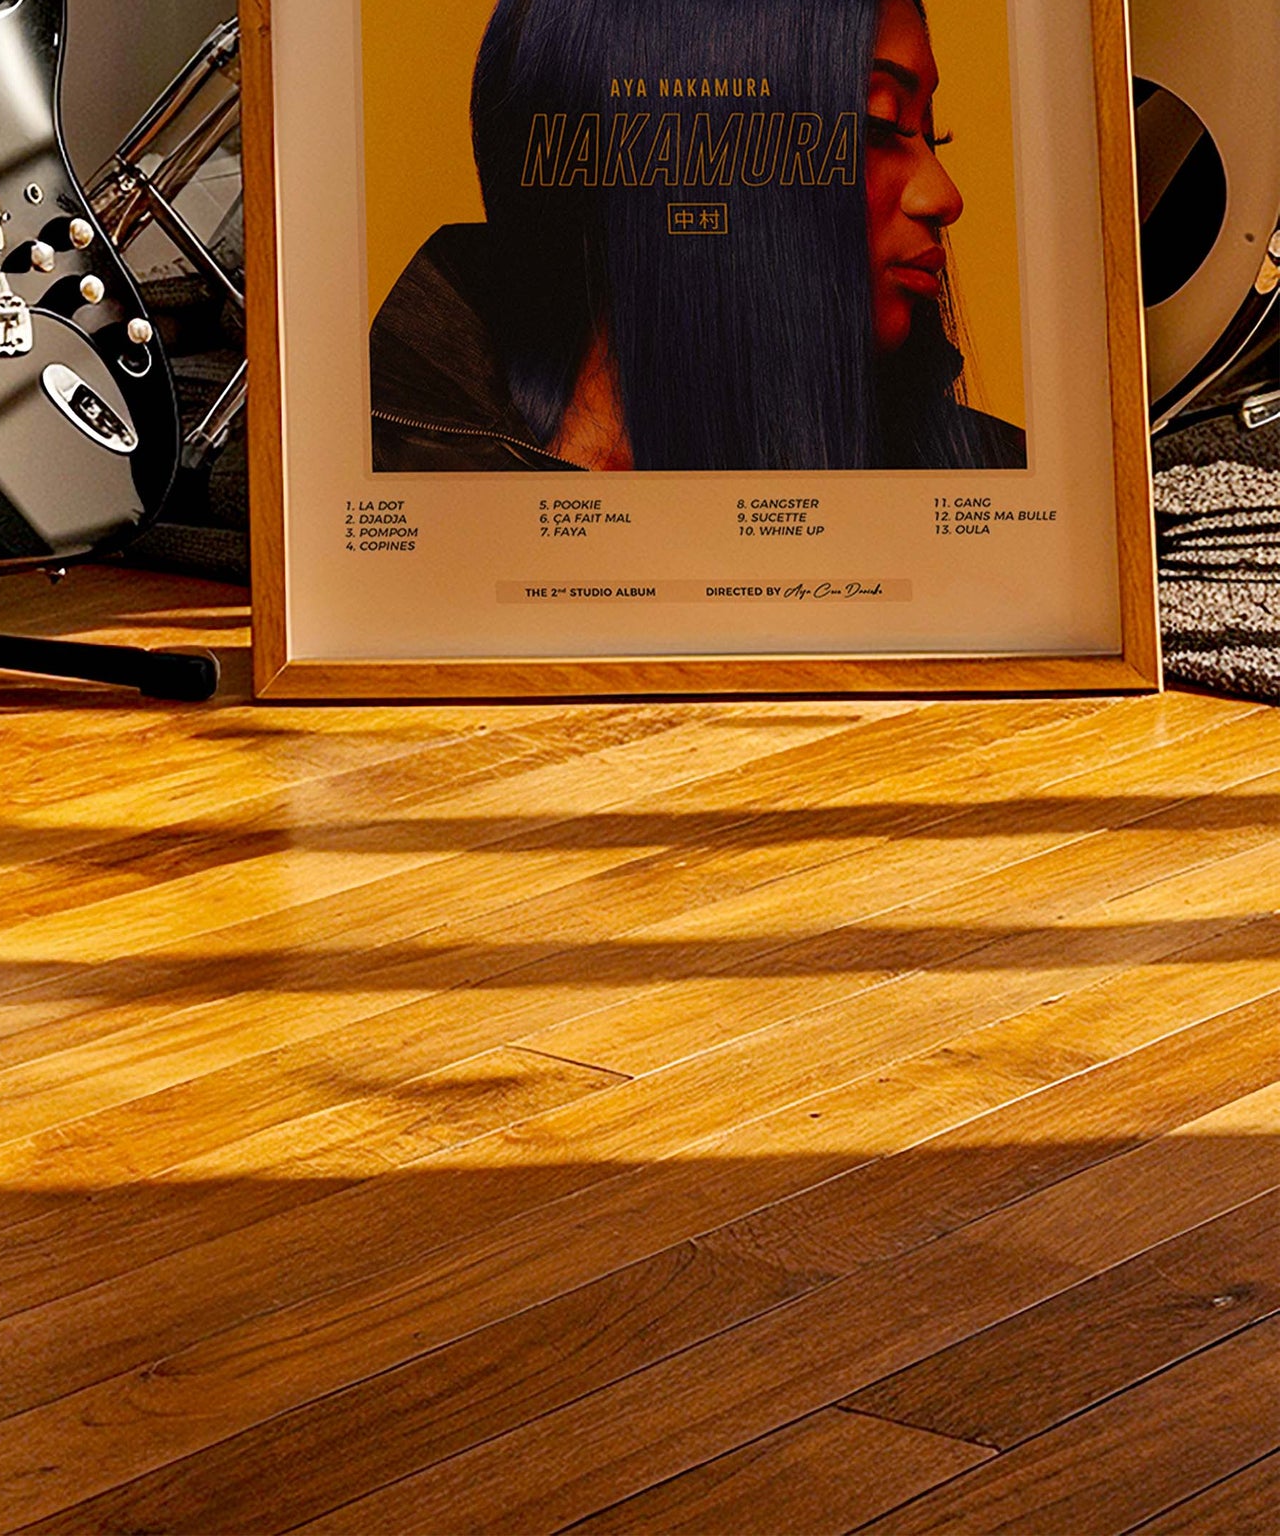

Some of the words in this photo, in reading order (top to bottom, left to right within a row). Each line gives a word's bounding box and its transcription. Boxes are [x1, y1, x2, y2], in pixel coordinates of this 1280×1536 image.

[610, 79, 647, 97] AYA
[659, 78, 770, 97] NAKAMURA
[520, 112, 858, 186] NAKAMURA
[674, 210, 720, 230] 中村
[346, 501, 355, 511] 1.
[358, 501, 374, 511] LA
[377, 500, 405, 511] DOT
[934, 497, 950, 508] 11.
[953, 497, 991, 508] GANG
[344, 514, 355, 524] 2.
[358, 513, 407, 524] DJADJA
[934, 511, 951, 521] 12.
[954, 510, 990, 521] DANS
[993, 511, 1014, 521] MA
[1017, 510, 1057, 521] BULLE
[345, 527, 355, 538] 3.
[359, 527, 418, 538] POMPOM
[935, 524, 951, 535] 13.
[954, 524, 990, 535] OULA
[345, 541, 356, 551] 4.
[359, 540, 415, 551] COPINES
[524, 587, 547, 597] THE
[551, 587, 566, 597] 2nd
[569, 587, 612, 597] STUDIO
[615, 587, 656, 597] ALBUM
